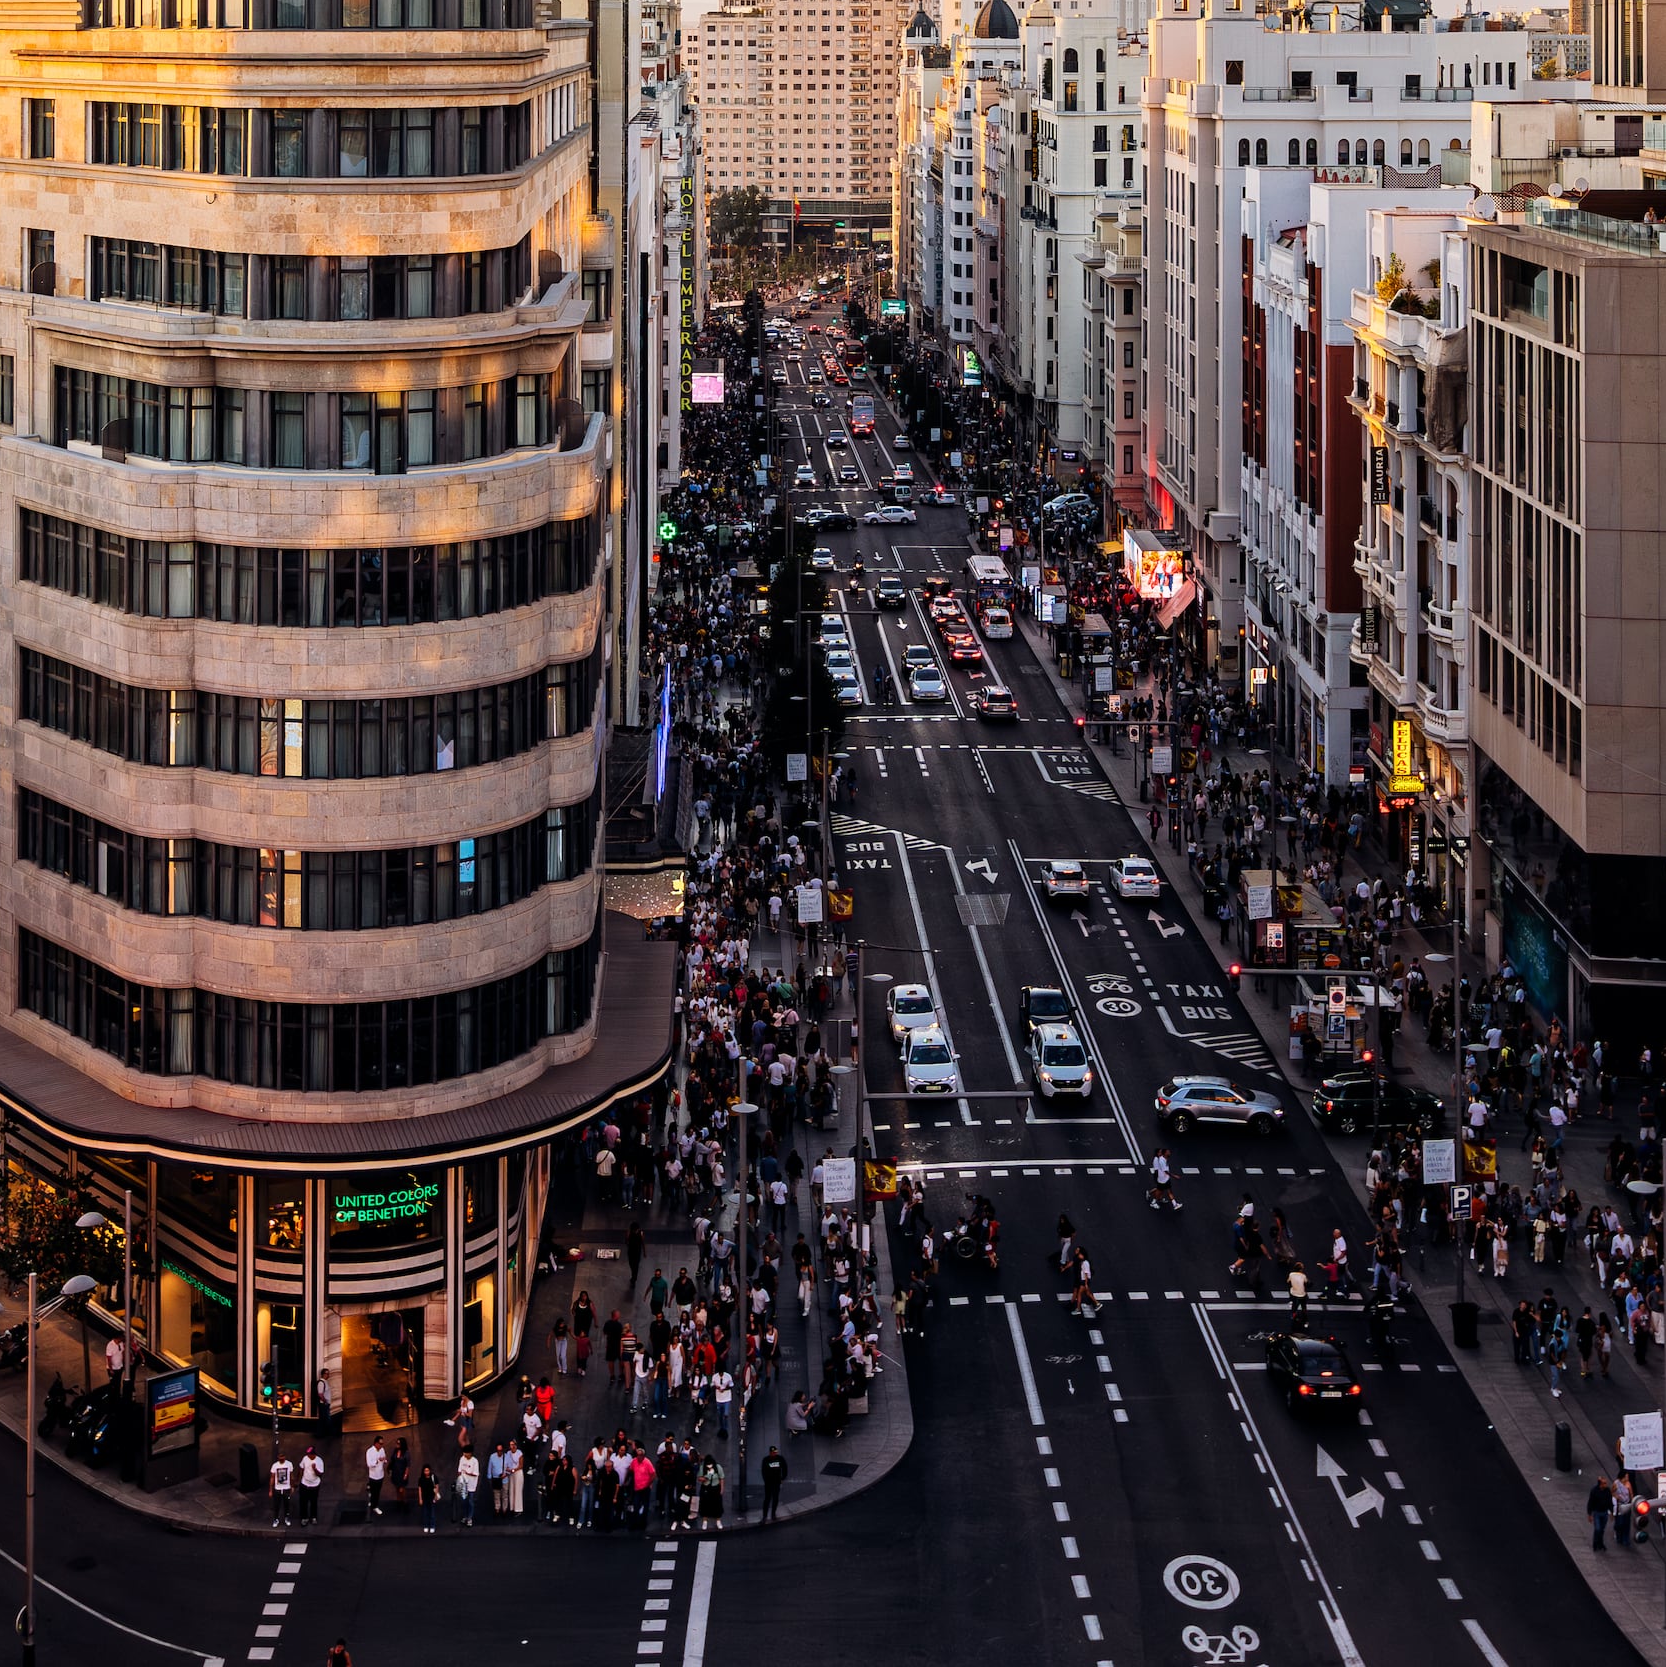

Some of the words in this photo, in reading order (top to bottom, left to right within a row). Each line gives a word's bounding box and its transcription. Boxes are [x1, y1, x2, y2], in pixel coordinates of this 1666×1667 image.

[680, 177, 693, 257] HOTEL
[680, 267, 693, 411] EMPERADOR
[1397, 721, 1408, 775] PELUCAS
[1047, 754, 1089, 763] TAXI
[1056, 766, 1093, 775] BUS
[845, 842, 885, 852] BUS
[845, 858, 892, 870] TAXI
[1166, 984, 1224, 998] TAXI
[1106, 1001, 1132, 1012] 30
[1181, 1005, 1233, 1020] BUS
[335, 1194, 385, 1207] UNITED
[388, 1184, 439, 1204] COLORS
[1453, 1187, 1469, 1208] P
[335, 1211, 356, 1222] OF
[1180, 1569, 1223, 1595] 30
